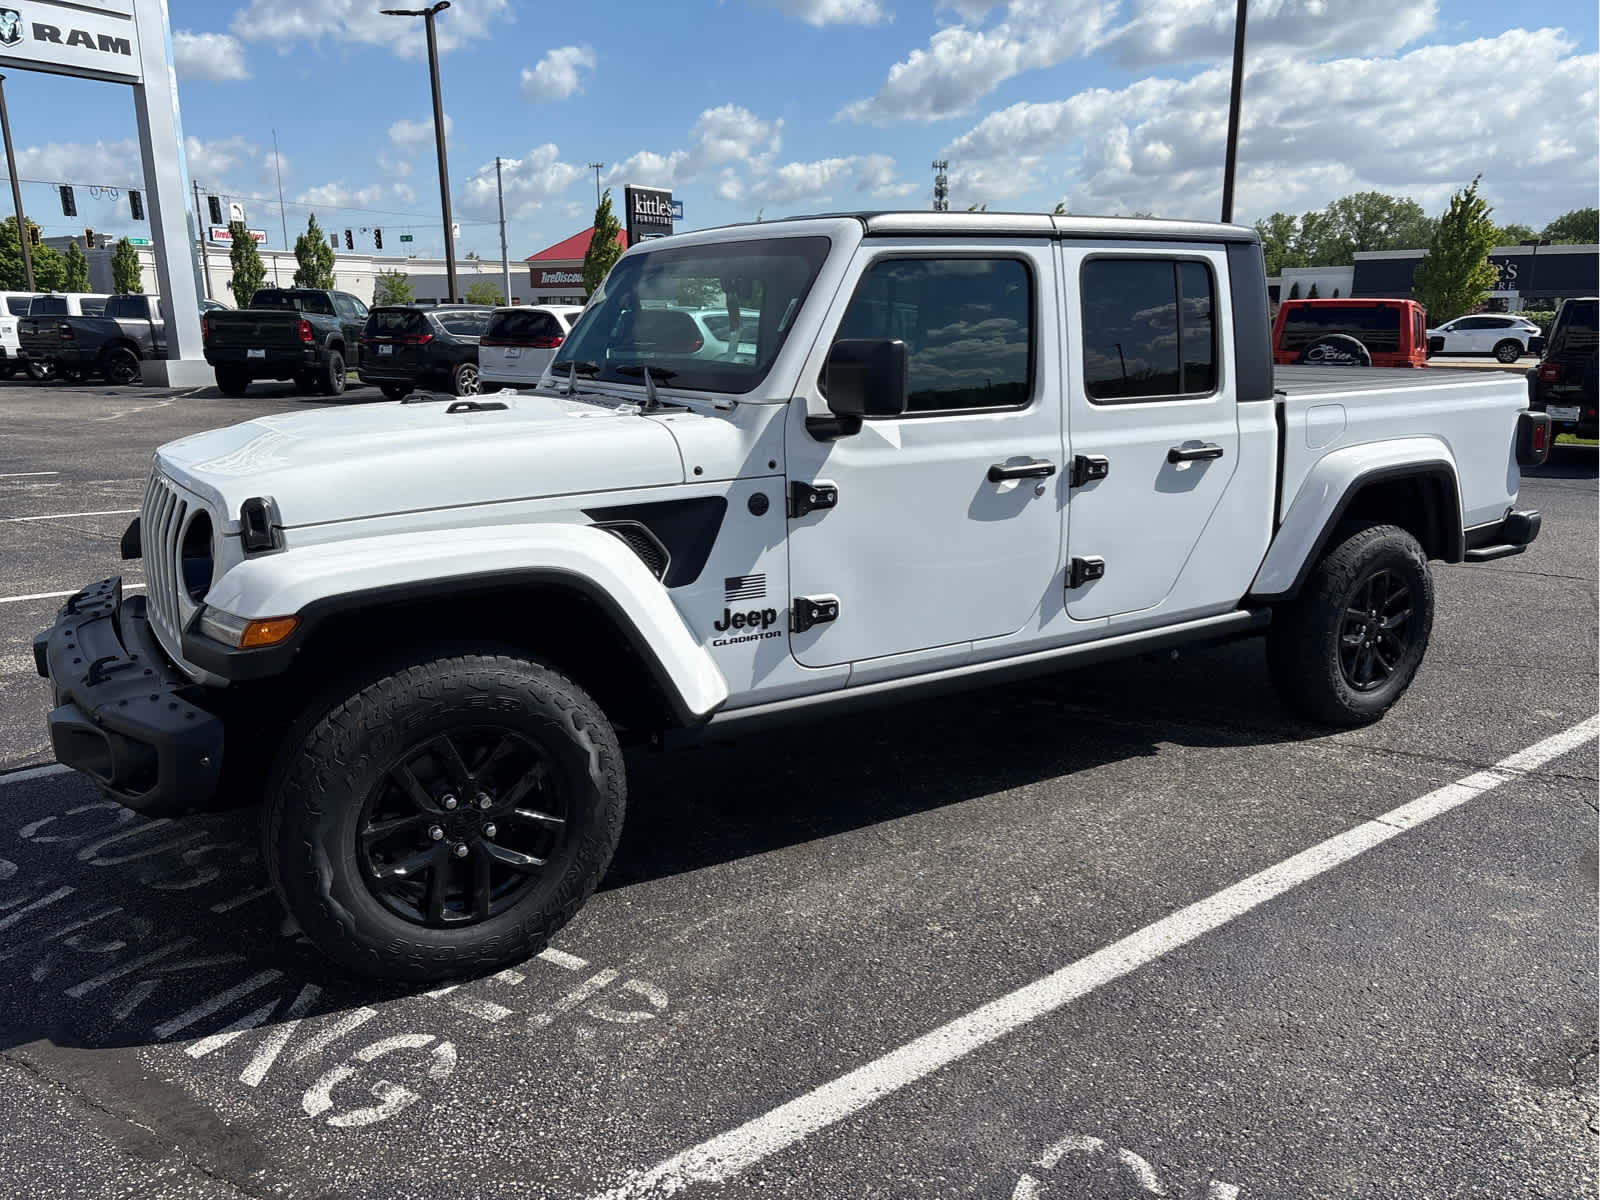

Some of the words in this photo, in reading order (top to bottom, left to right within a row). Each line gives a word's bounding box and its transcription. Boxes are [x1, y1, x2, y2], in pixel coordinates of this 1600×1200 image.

[32, 22, 131, 56] RAM
[635, 193, 672, 217] kittle's
[541, 271, 584, 284] TireDiscou
[714, 608, 777, 632] Jeep
[713, 630, 782, 647] GLADIATOR
